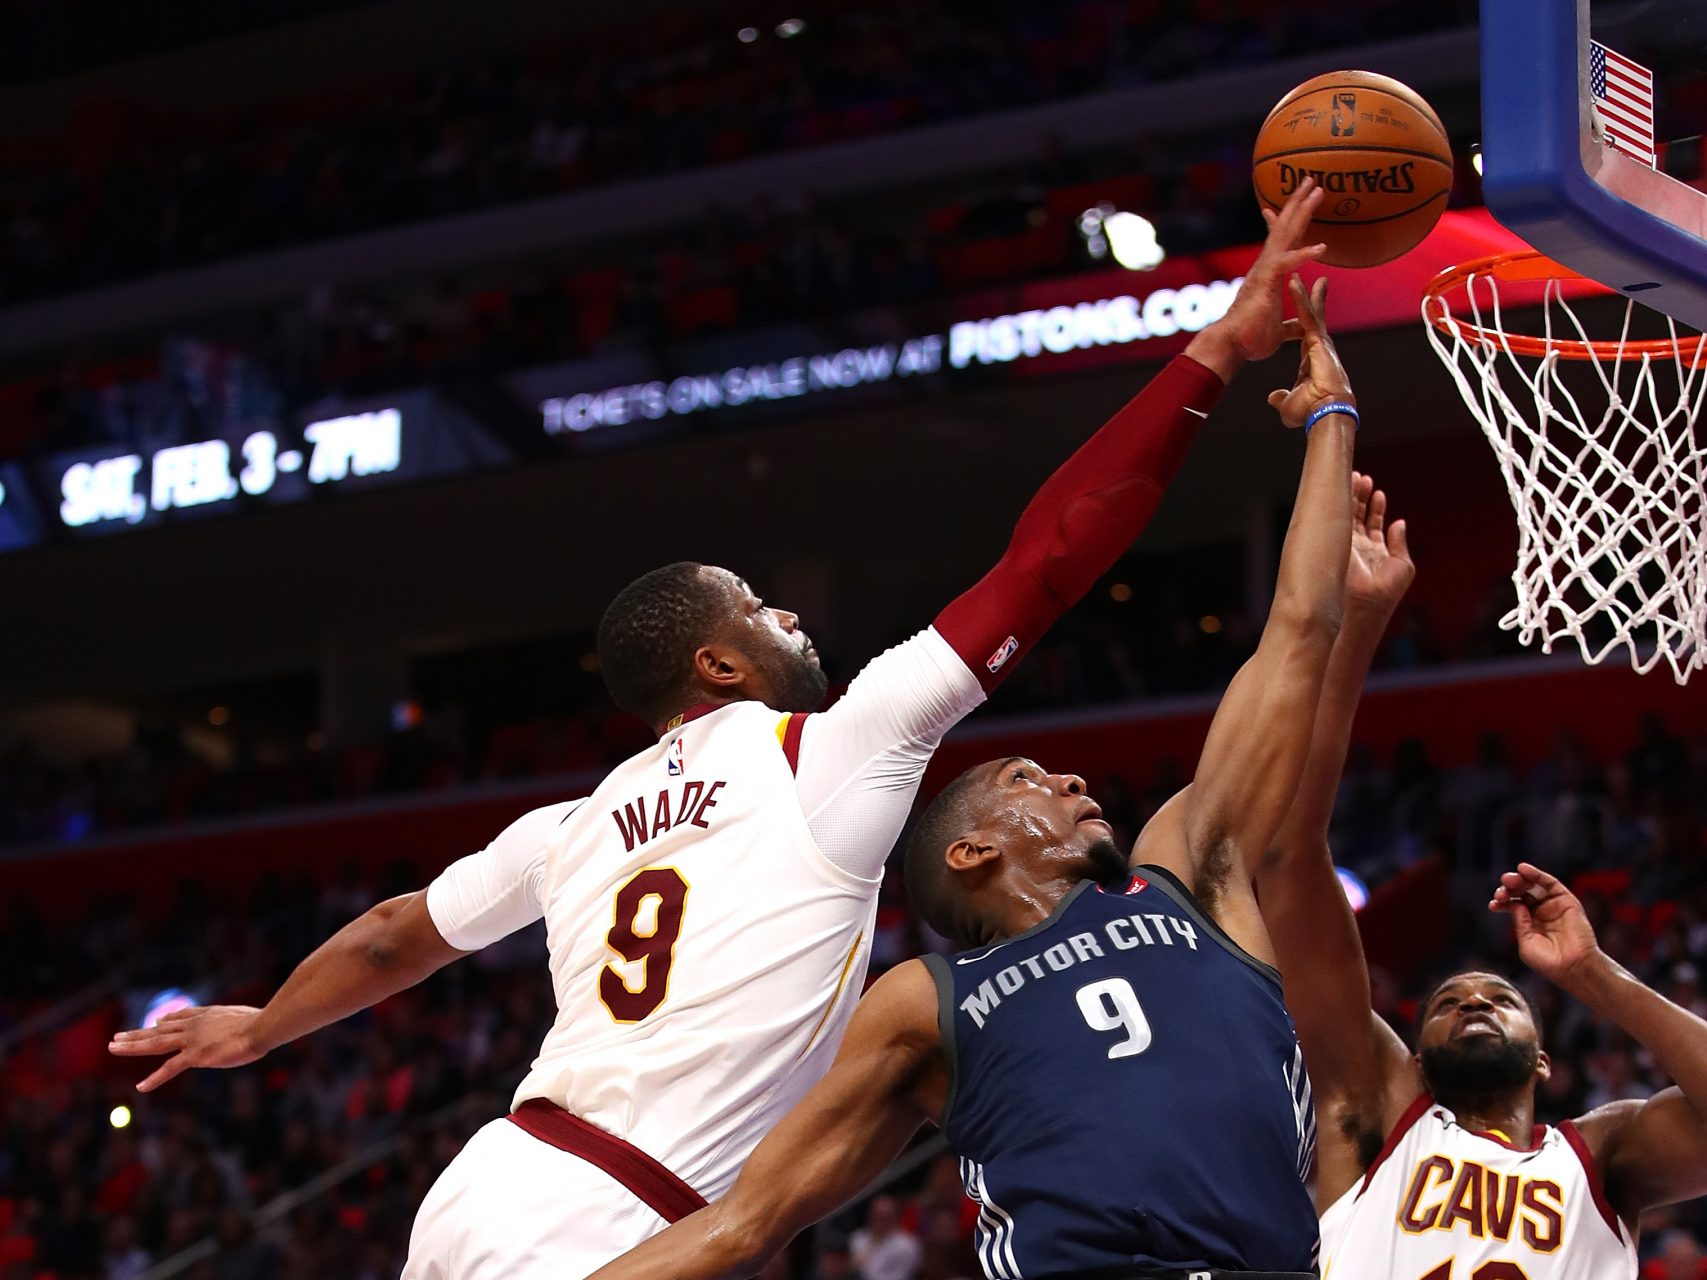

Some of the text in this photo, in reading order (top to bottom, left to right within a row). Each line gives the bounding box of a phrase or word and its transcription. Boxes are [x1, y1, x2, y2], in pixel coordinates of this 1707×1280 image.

[667, 375, 722, 415] ON
[721, 356, 808, 407] SALE
[807, 342, 899, 392] NOW
[240, 430, 278, 495] 3
[303, 407, 403, 485] 7PM
[611, 780, 727, 852] WADE
[597, 865, 691, 1025] 9
[959, 913, 1199, 1030] MOTOR CITY
[1074, 975, 1153, 1061] 9
[1396, 1153, 1564, 1256] CAVS
